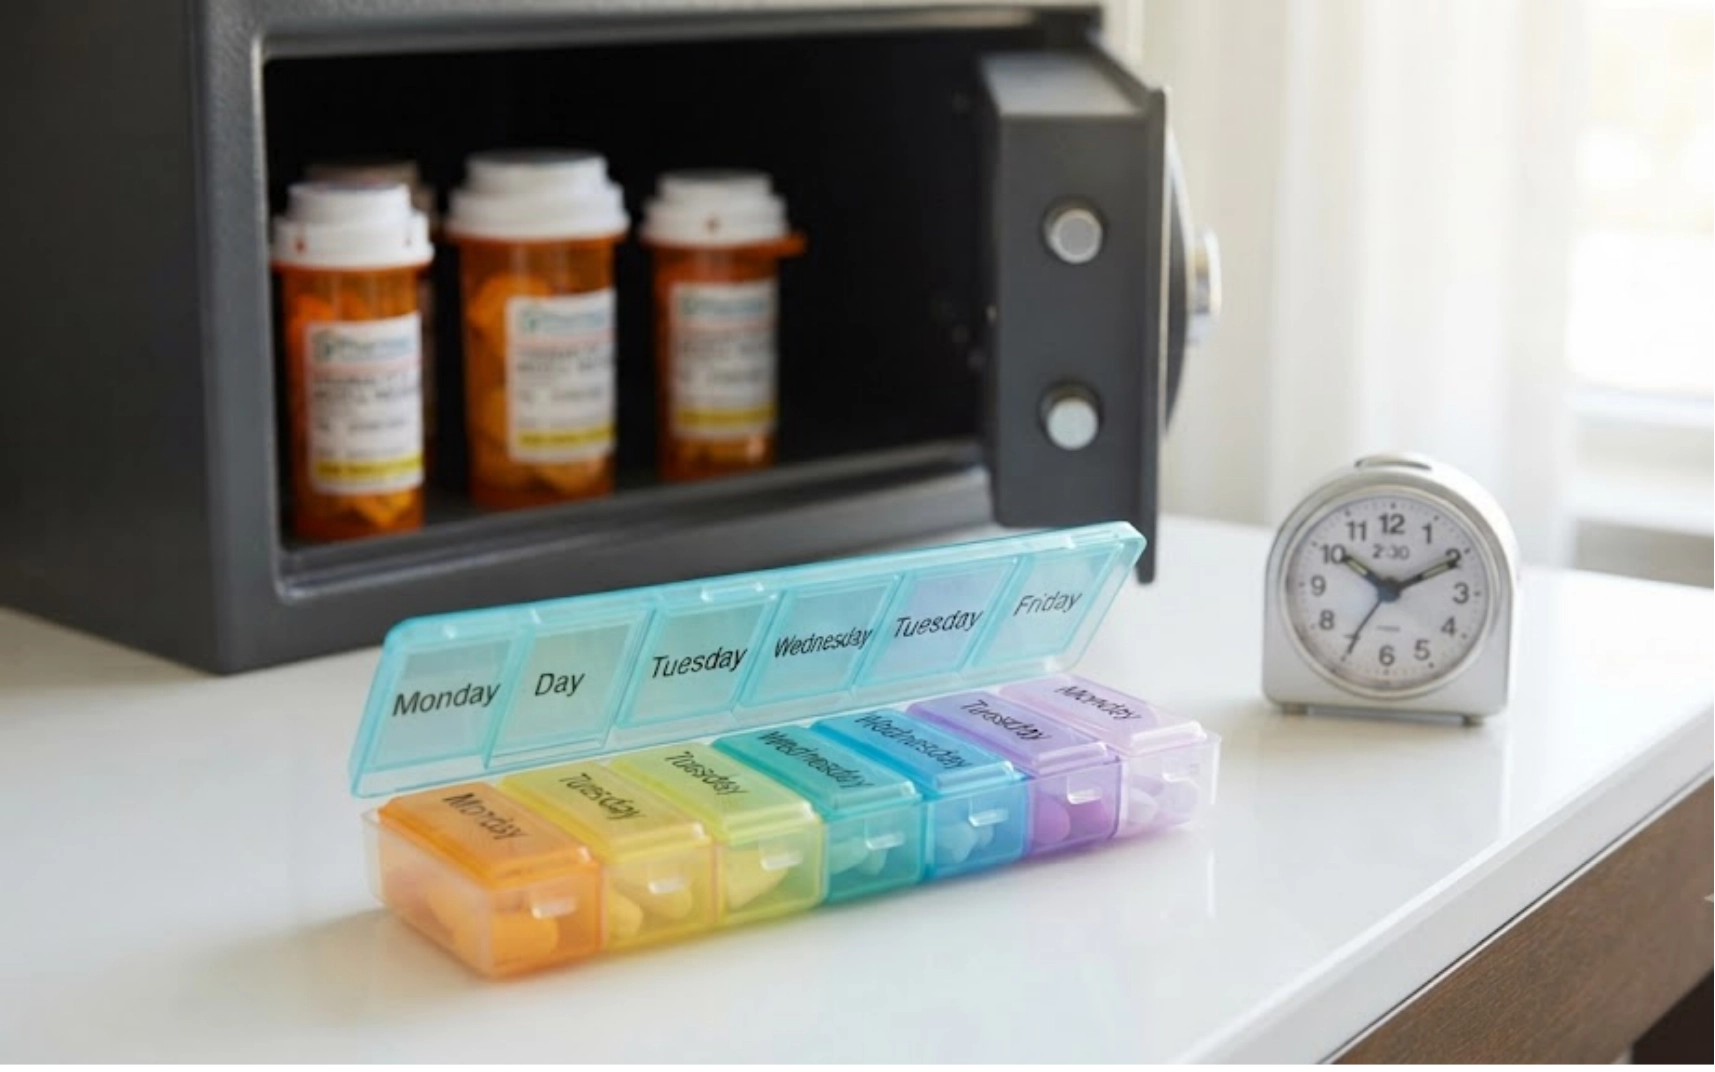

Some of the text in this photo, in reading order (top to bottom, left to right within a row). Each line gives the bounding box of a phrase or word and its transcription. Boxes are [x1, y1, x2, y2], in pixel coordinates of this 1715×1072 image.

[1346, 521, 1368, 540] 11
[1378, 513, 1405, 534] 12
[1422, 523, 1433, 544] 1
[1321, 544, 1347, 564] 10
[1445, 548, 1461, 568] 2
[1311, 575, 1325, 596] 9
[1453, 583, 1468, 604] 3
[1319, 610, 1335, 630] 8
[1441, 616, 1456, 636] 4
[392, 590, 1083, 716] Monday Day Tuesday Wednesday Tuesday Friday
[1379, 645, 1394, 666] 6
[1414, 639, 1430, 660] 5
